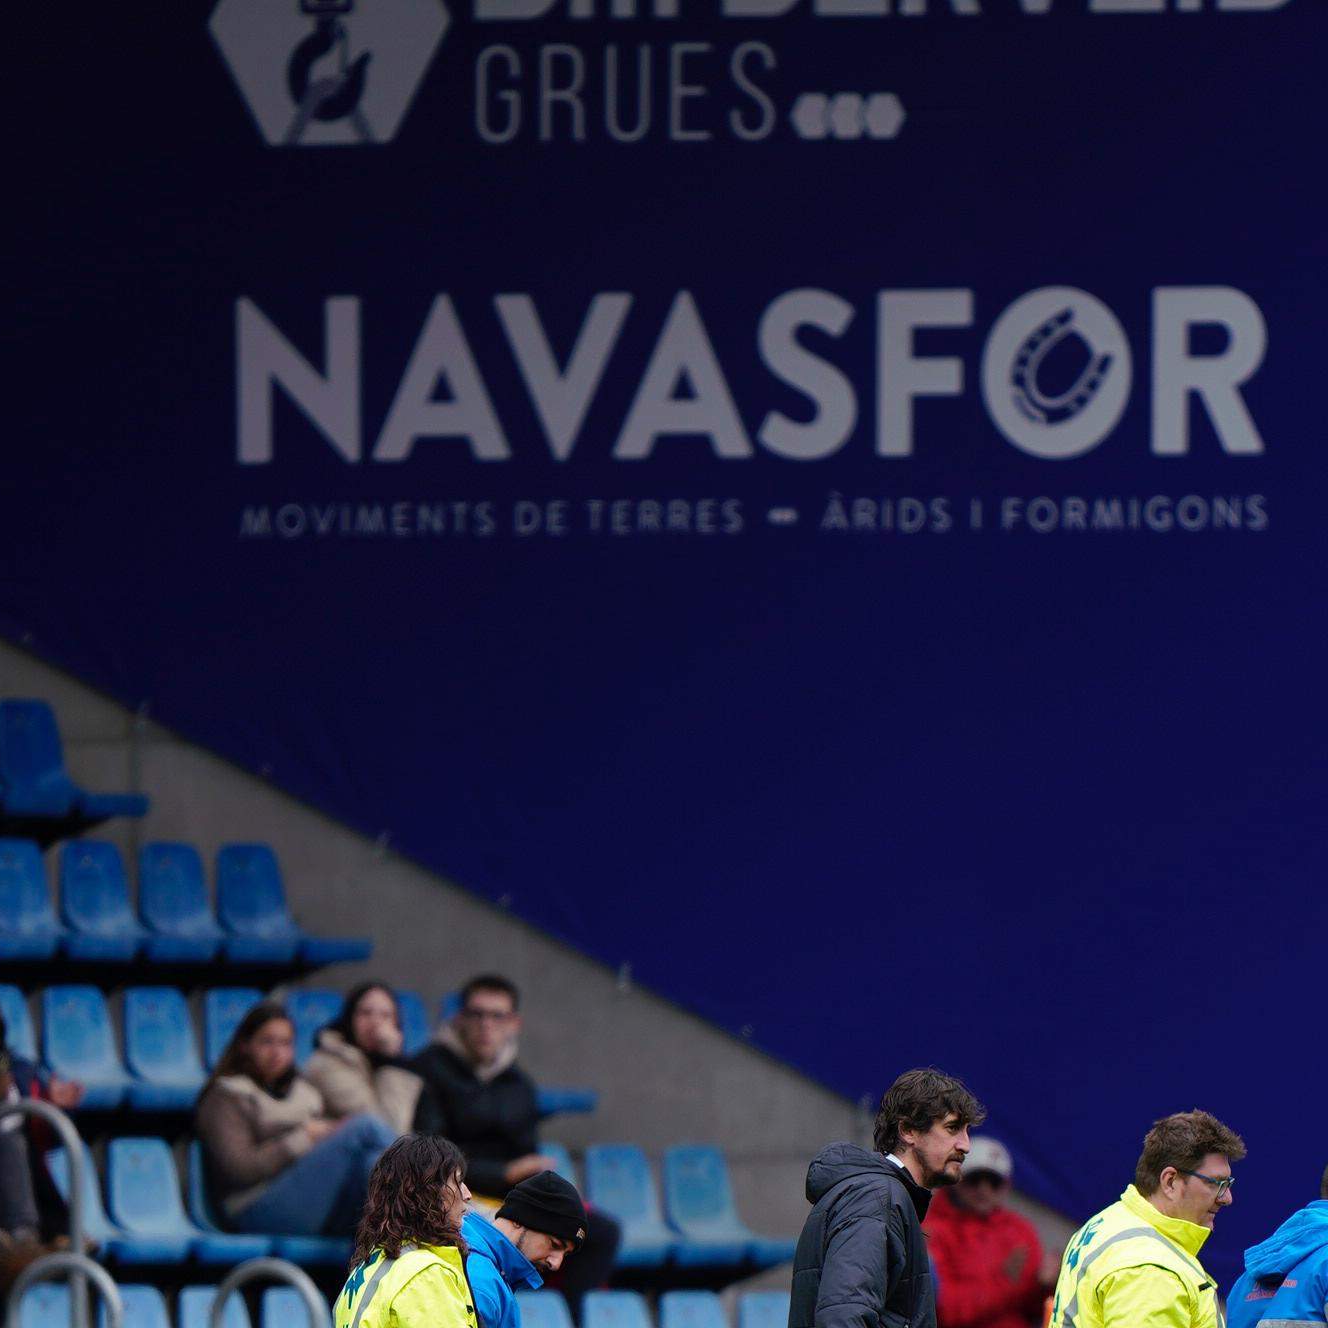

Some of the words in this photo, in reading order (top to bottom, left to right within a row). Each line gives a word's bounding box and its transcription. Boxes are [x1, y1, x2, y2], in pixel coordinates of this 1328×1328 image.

[474, 42, 779, 143] GRUES
[236, 285, 1268, 464] NAVASFOR
[238, 502, 496, 538] MOVIMENTS
[512, 500, 570, 535] DE
[585, 498, 745, 535] TERRES
[1000, 494, 1270, 533] FORMIGONS
